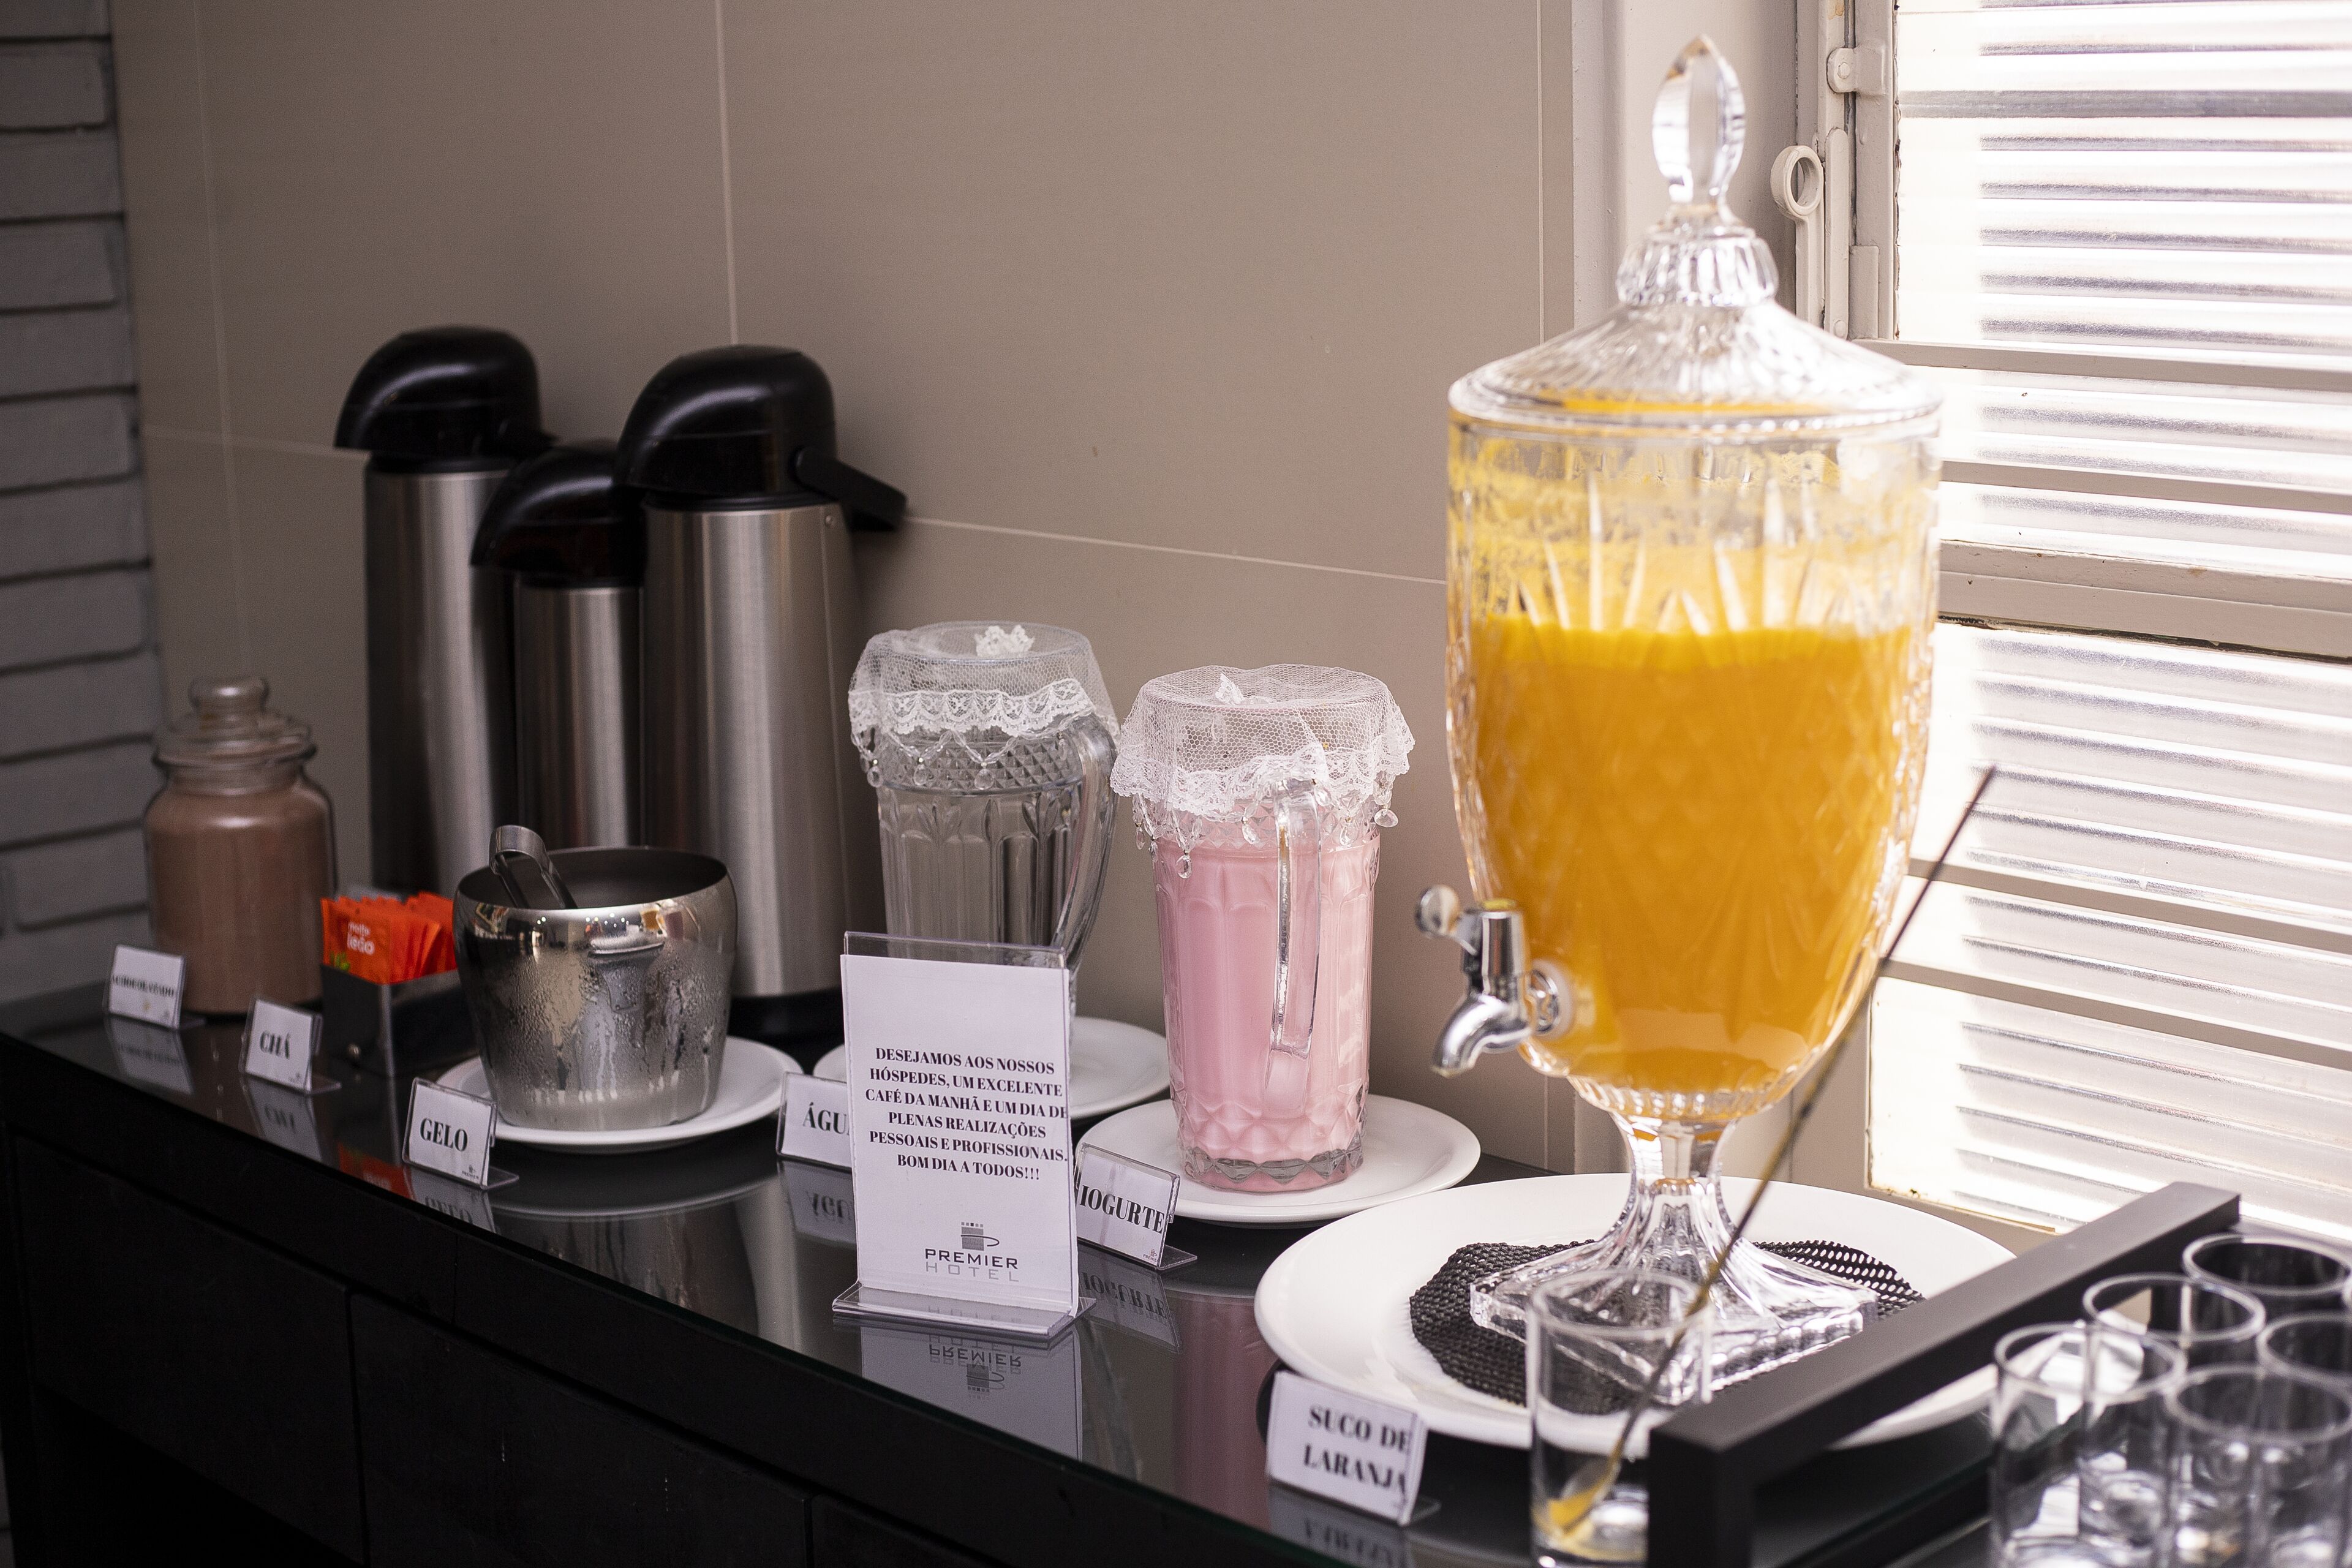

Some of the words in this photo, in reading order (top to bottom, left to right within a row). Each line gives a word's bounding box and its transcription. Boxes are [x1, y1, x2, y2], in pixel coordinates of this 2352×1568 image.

[260, 1030, 290, 1060] CHÁ
[876, 1047, 962, 1067] DESEJAMOS
[965, 1055, 994, 1069] AOS
[997, 1058, 1055, 1074] NOSSOS
[870, 1066, 950, 1088] HÓSPEDES,
[953, 1075, 974, 1089] UM
[978, 1077, 1063, 1097] EXCELENTE
[865, 1088, 902, 1104] CAFÉ
[905, 1092, 926, 1106] DA
[928, 1094, 981, 1112] MANHÃ
[983, 1099, 992, 1113] E
[995, 1101, 1016, 1115] UM
[1020, 1103, 1046, 1117] DIA
[1049, 1106, 1068, 1119] DE
[802, 1102, 850, 1136] ÁGU
[889, 1111, 943, 1129] PLENAS
[946, 1117, 1047, 1139] REALIZAÇÕES
[420, 1117, 468, 1152] GELO
[870, 1131, 938, 1149] PESSOAIS
[941, 1138, 950, 1150] E
[952, 1139, 1068, 1161] PROFISSIONAIS.
[897, 1154, 929, 1169] BOM
[932, 1158, 958, 1172] DIA
[960, 1161, 970, 1173] A
[973, 1162, 1039, 1180] TODOS!!!
[1079, 1185, 1165, 1234] IOGURTE
[925, 1248, 1019, 1270] PREMIER
[925, 1261, 1019, 1282] HOTEL
[1143, 1253, 1158, 1262] PREMIE
[1308, 1404, 1371, 1442] SUCO
[1380, 1425, 1411, 1452] DE
[1303, 1444, 1407, 1497] LARANJA
